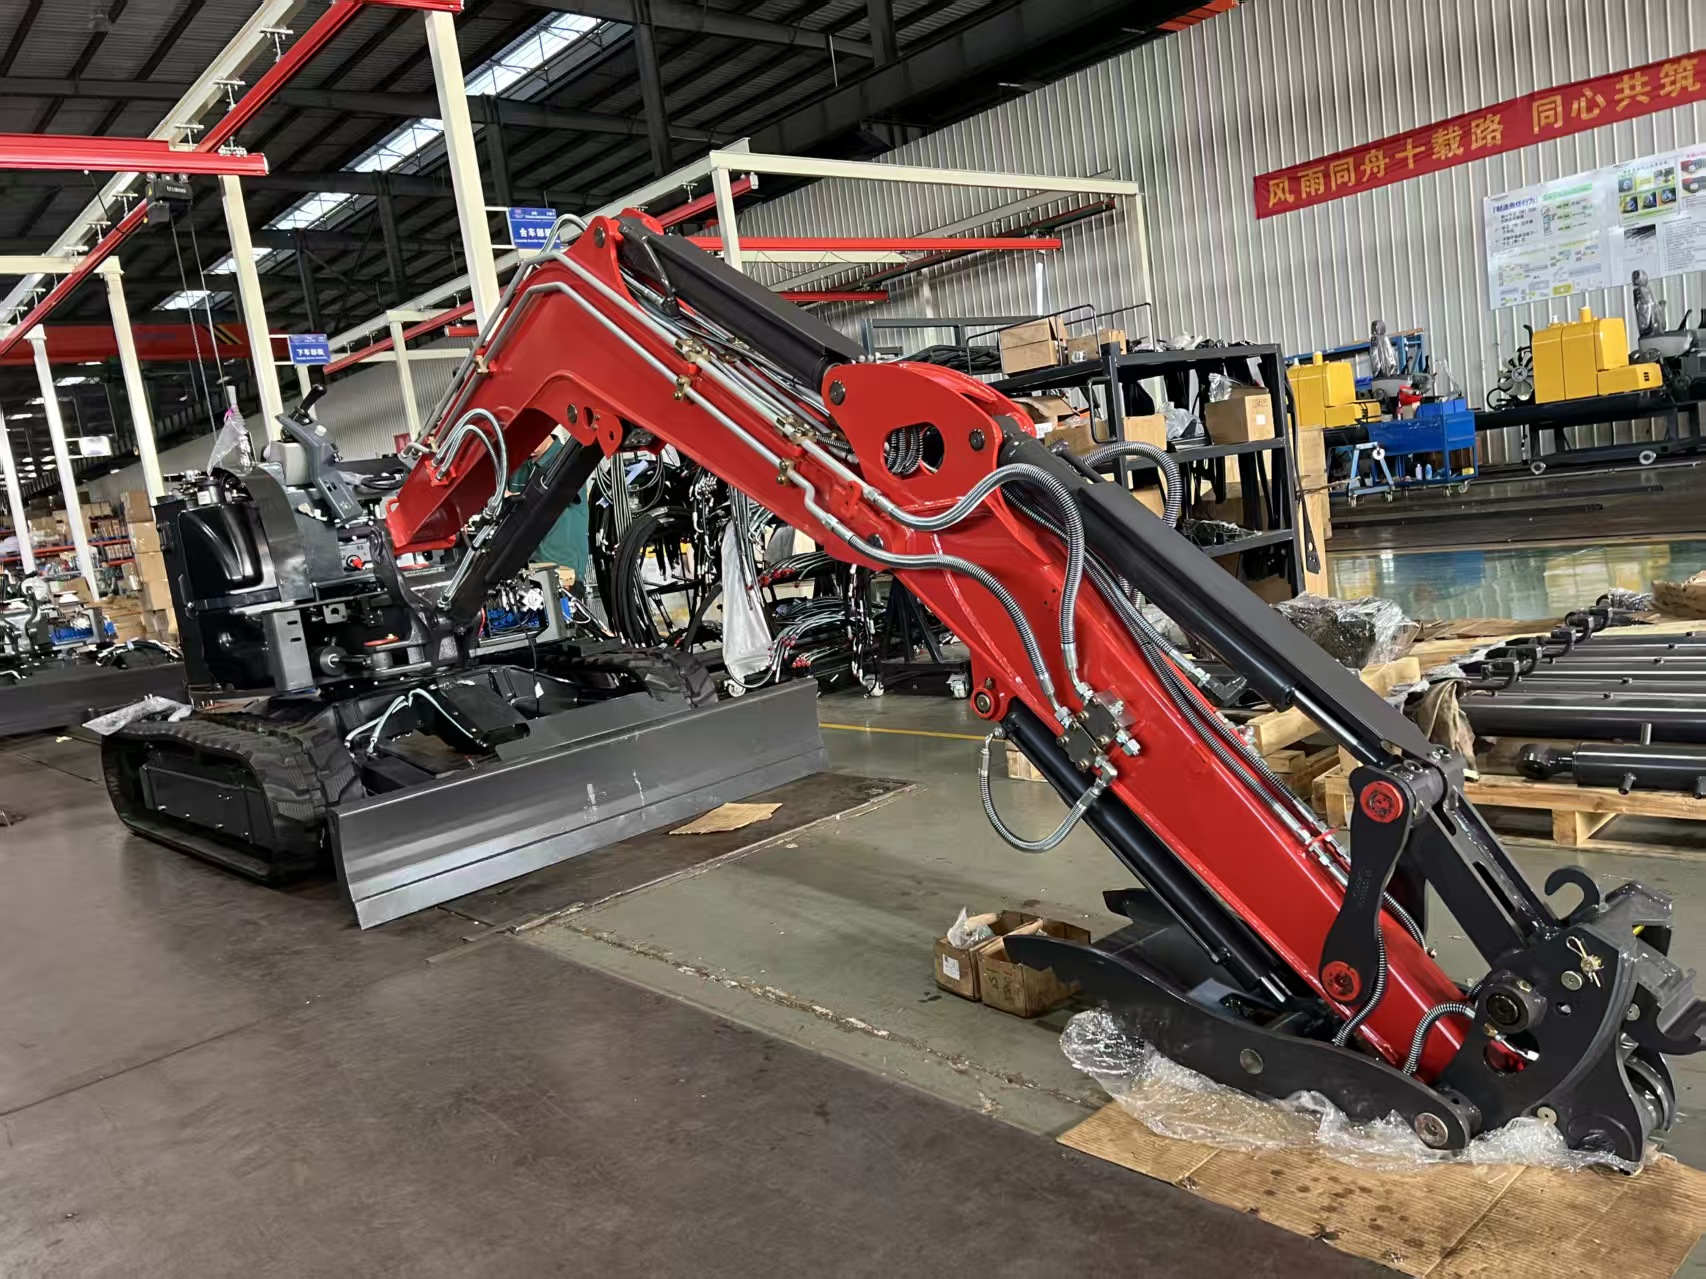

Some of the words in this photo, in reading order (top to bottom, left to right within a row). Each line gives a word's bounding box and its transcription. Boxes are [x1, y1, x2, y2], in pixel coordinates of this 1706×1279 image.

[1267, 113, 1505, 208] 风雨同舟十载路
[1531, 57, 1702, 135] 同心共筑
